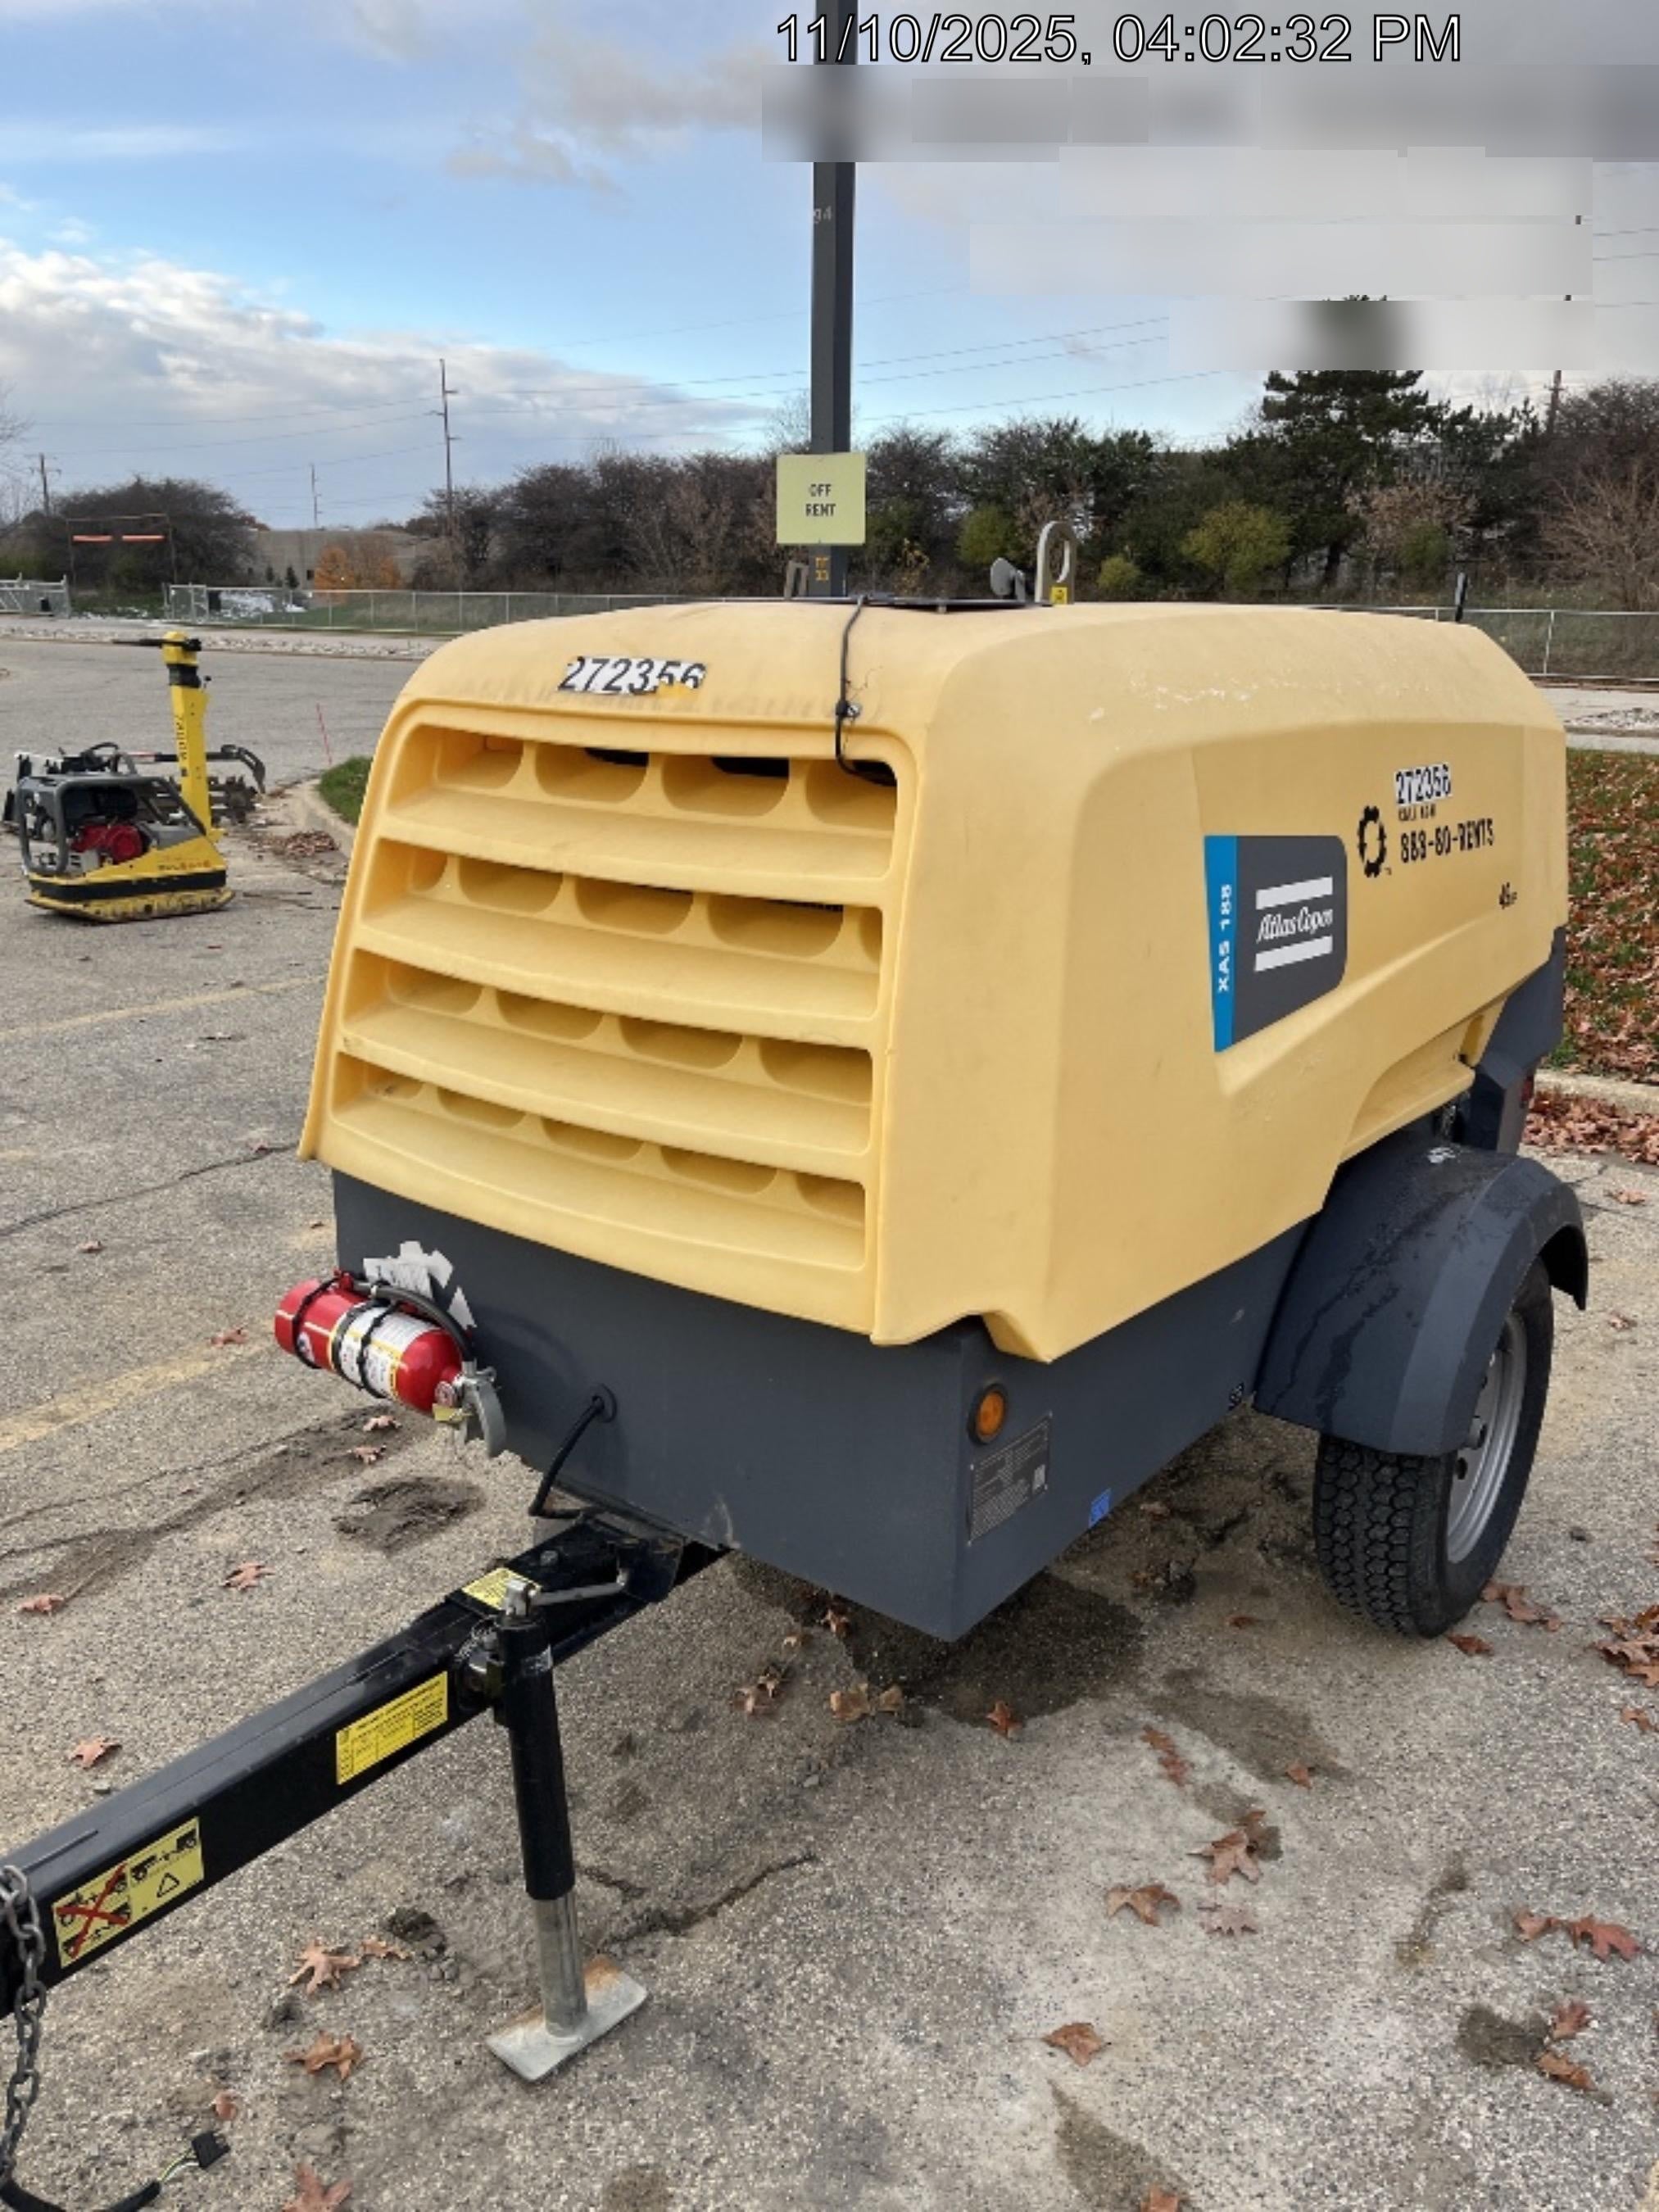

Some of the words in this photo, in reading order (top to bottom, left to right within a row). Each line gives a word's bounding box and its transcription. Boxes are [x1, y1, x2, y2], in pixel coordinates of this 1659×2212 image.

[809, 483, 832, 497] OFF
[805, 503, 836, 517] RENT
[557, 655, 706, 696] 272356
[1395, 763, 1452, 805] 272356
[1256, 913, 1296, 944] Atlas
[1218, 941, 1231, 993] XAS
